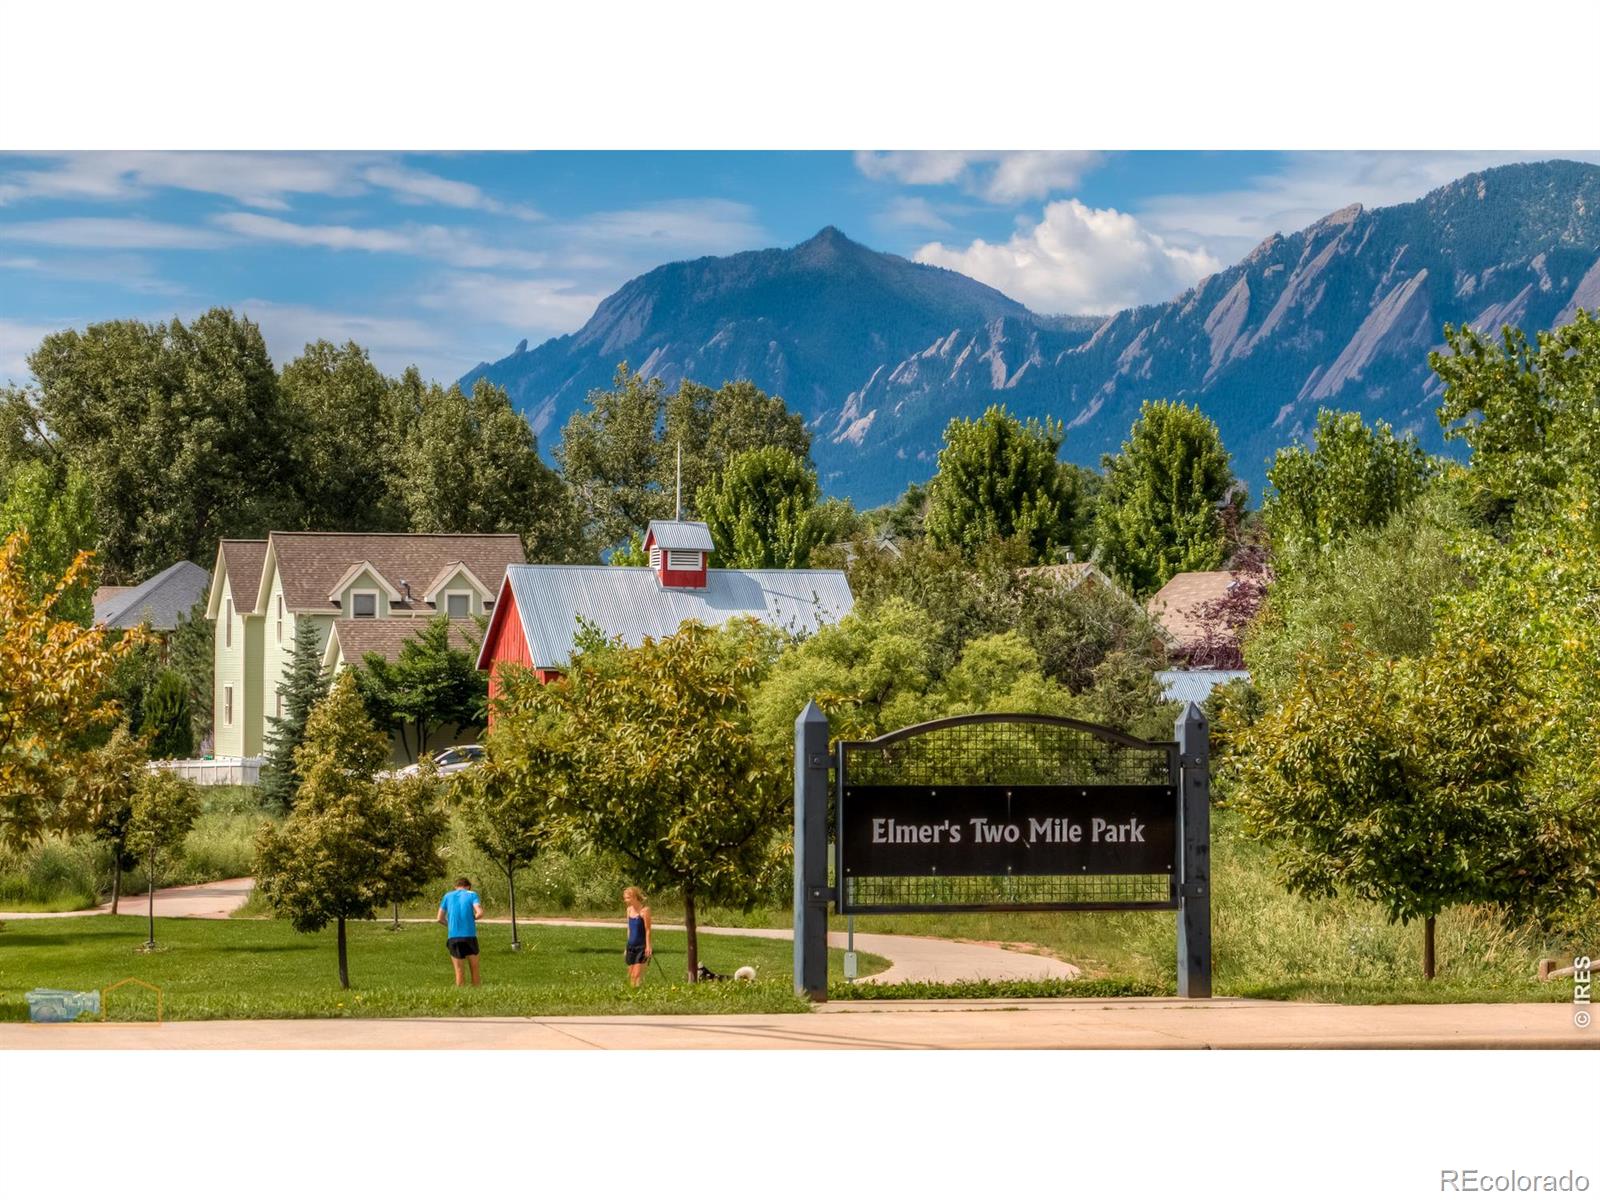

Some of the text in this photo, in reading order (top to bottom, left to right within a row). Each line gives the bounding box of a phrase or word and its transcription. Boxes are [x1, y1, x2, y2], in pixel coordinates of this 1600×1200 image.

[872, 817, 1145, 844] Elmer's Two Mile Park
